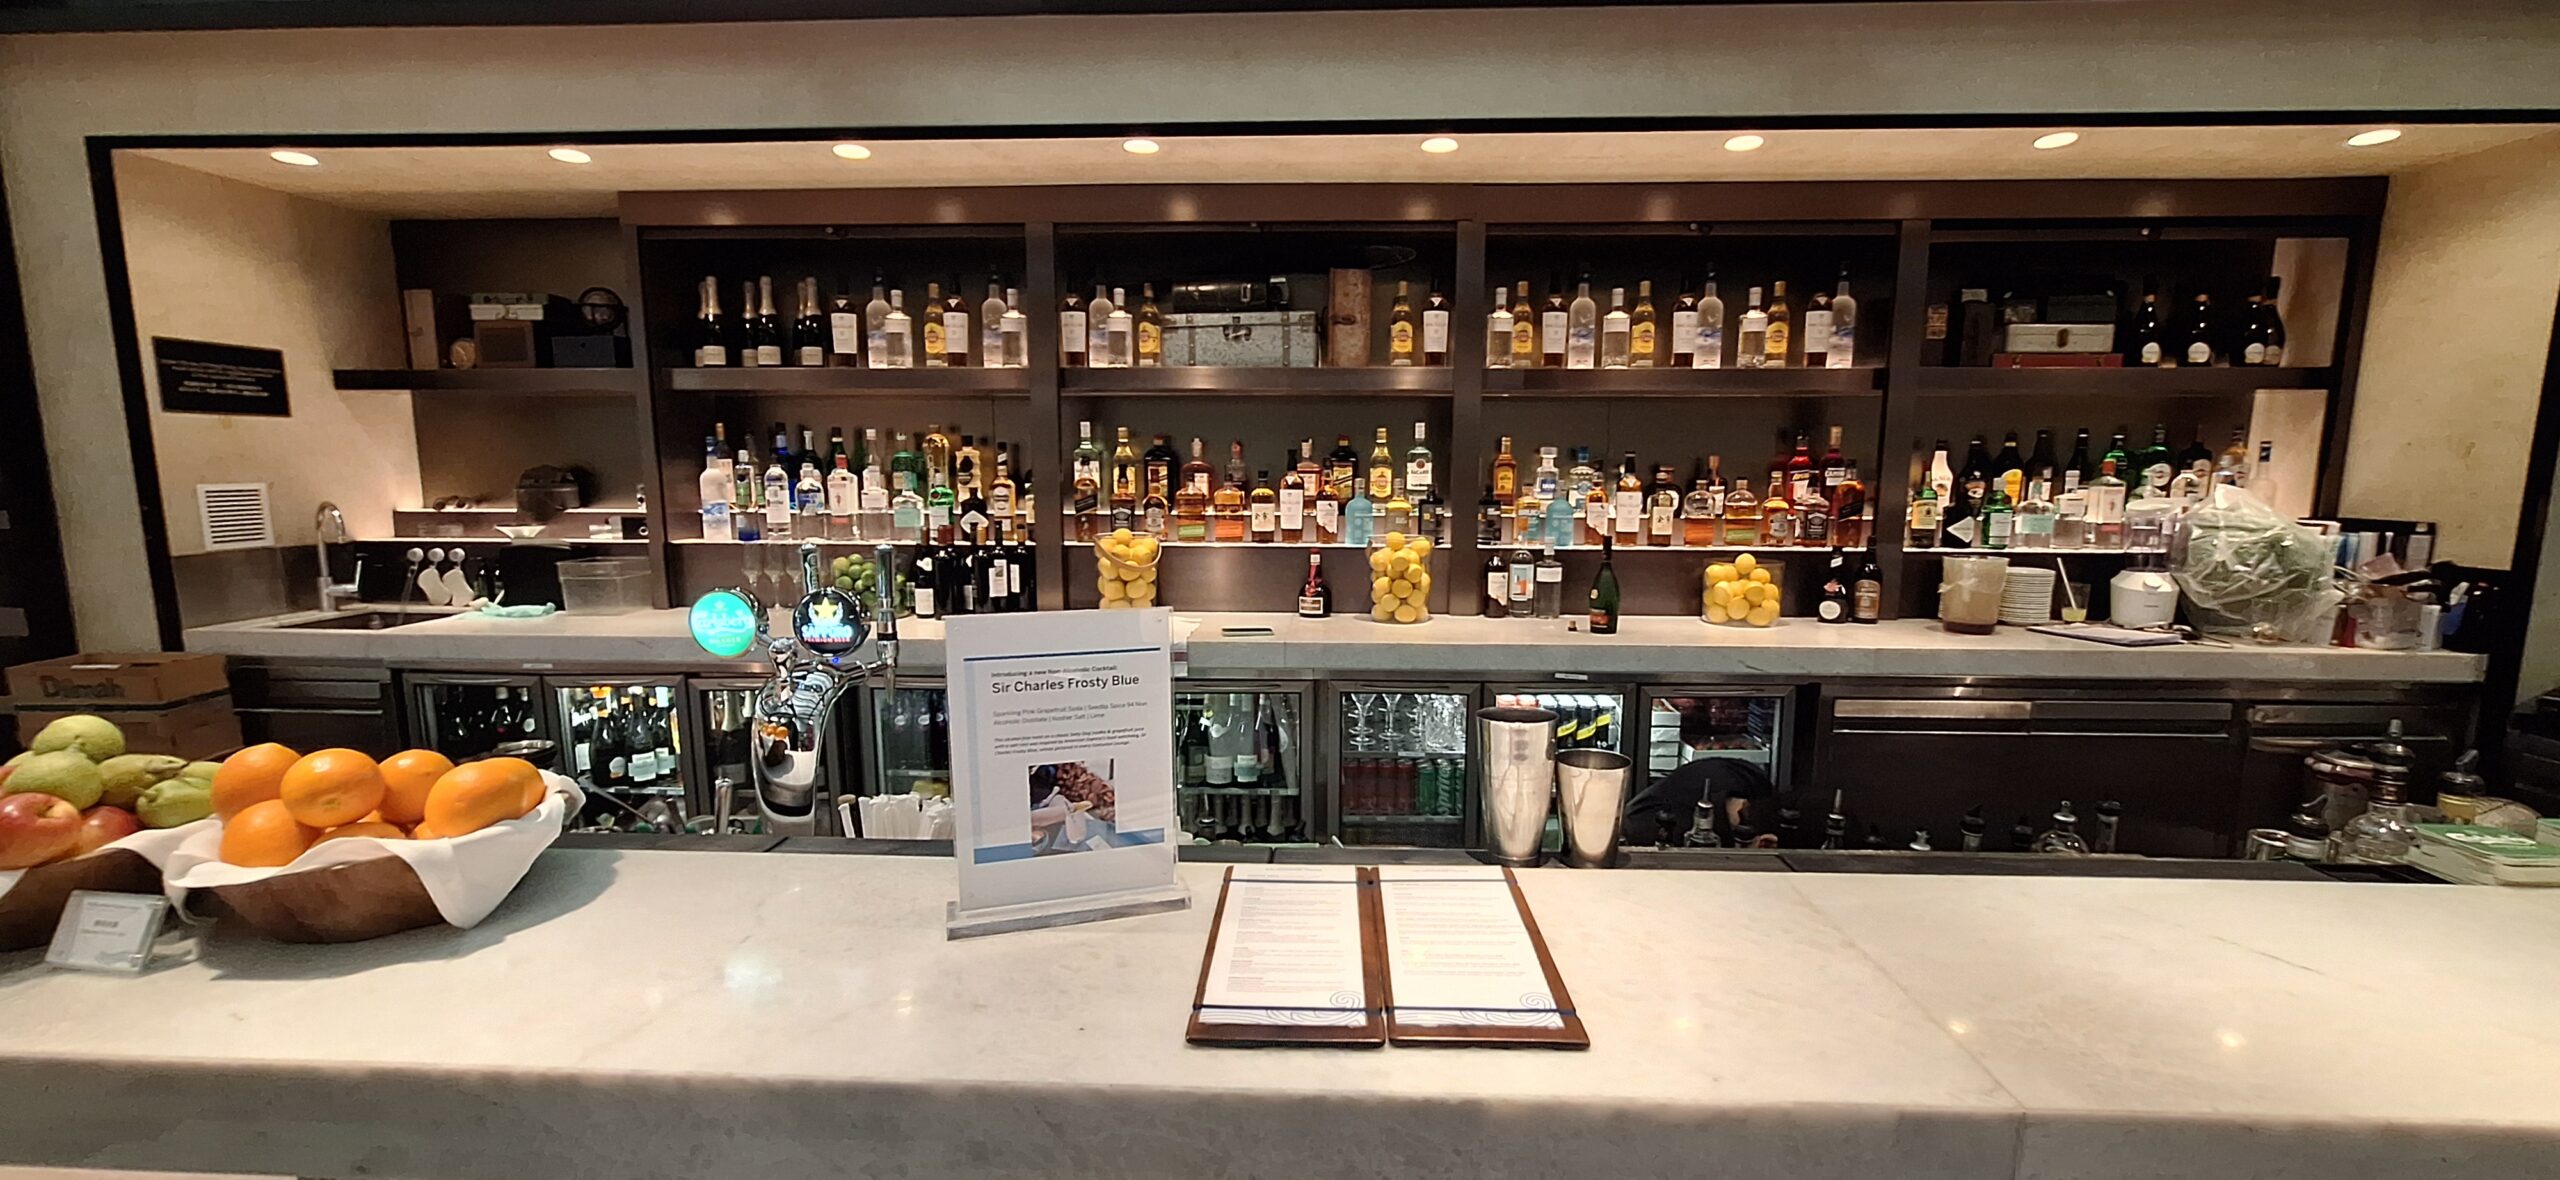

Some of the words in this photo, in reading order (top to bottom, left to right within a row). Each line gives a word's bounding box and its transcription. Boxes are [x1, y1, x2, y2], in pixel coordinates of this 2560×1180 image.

[991, 670, 1027, 678] Introducing
[991, 682, 1011, 694] Sir
[1014, 679, 1065, 693] Charles
[1068, 677, 1109, 690] Frosty
[1112, 674, 1140, 686] Blue
